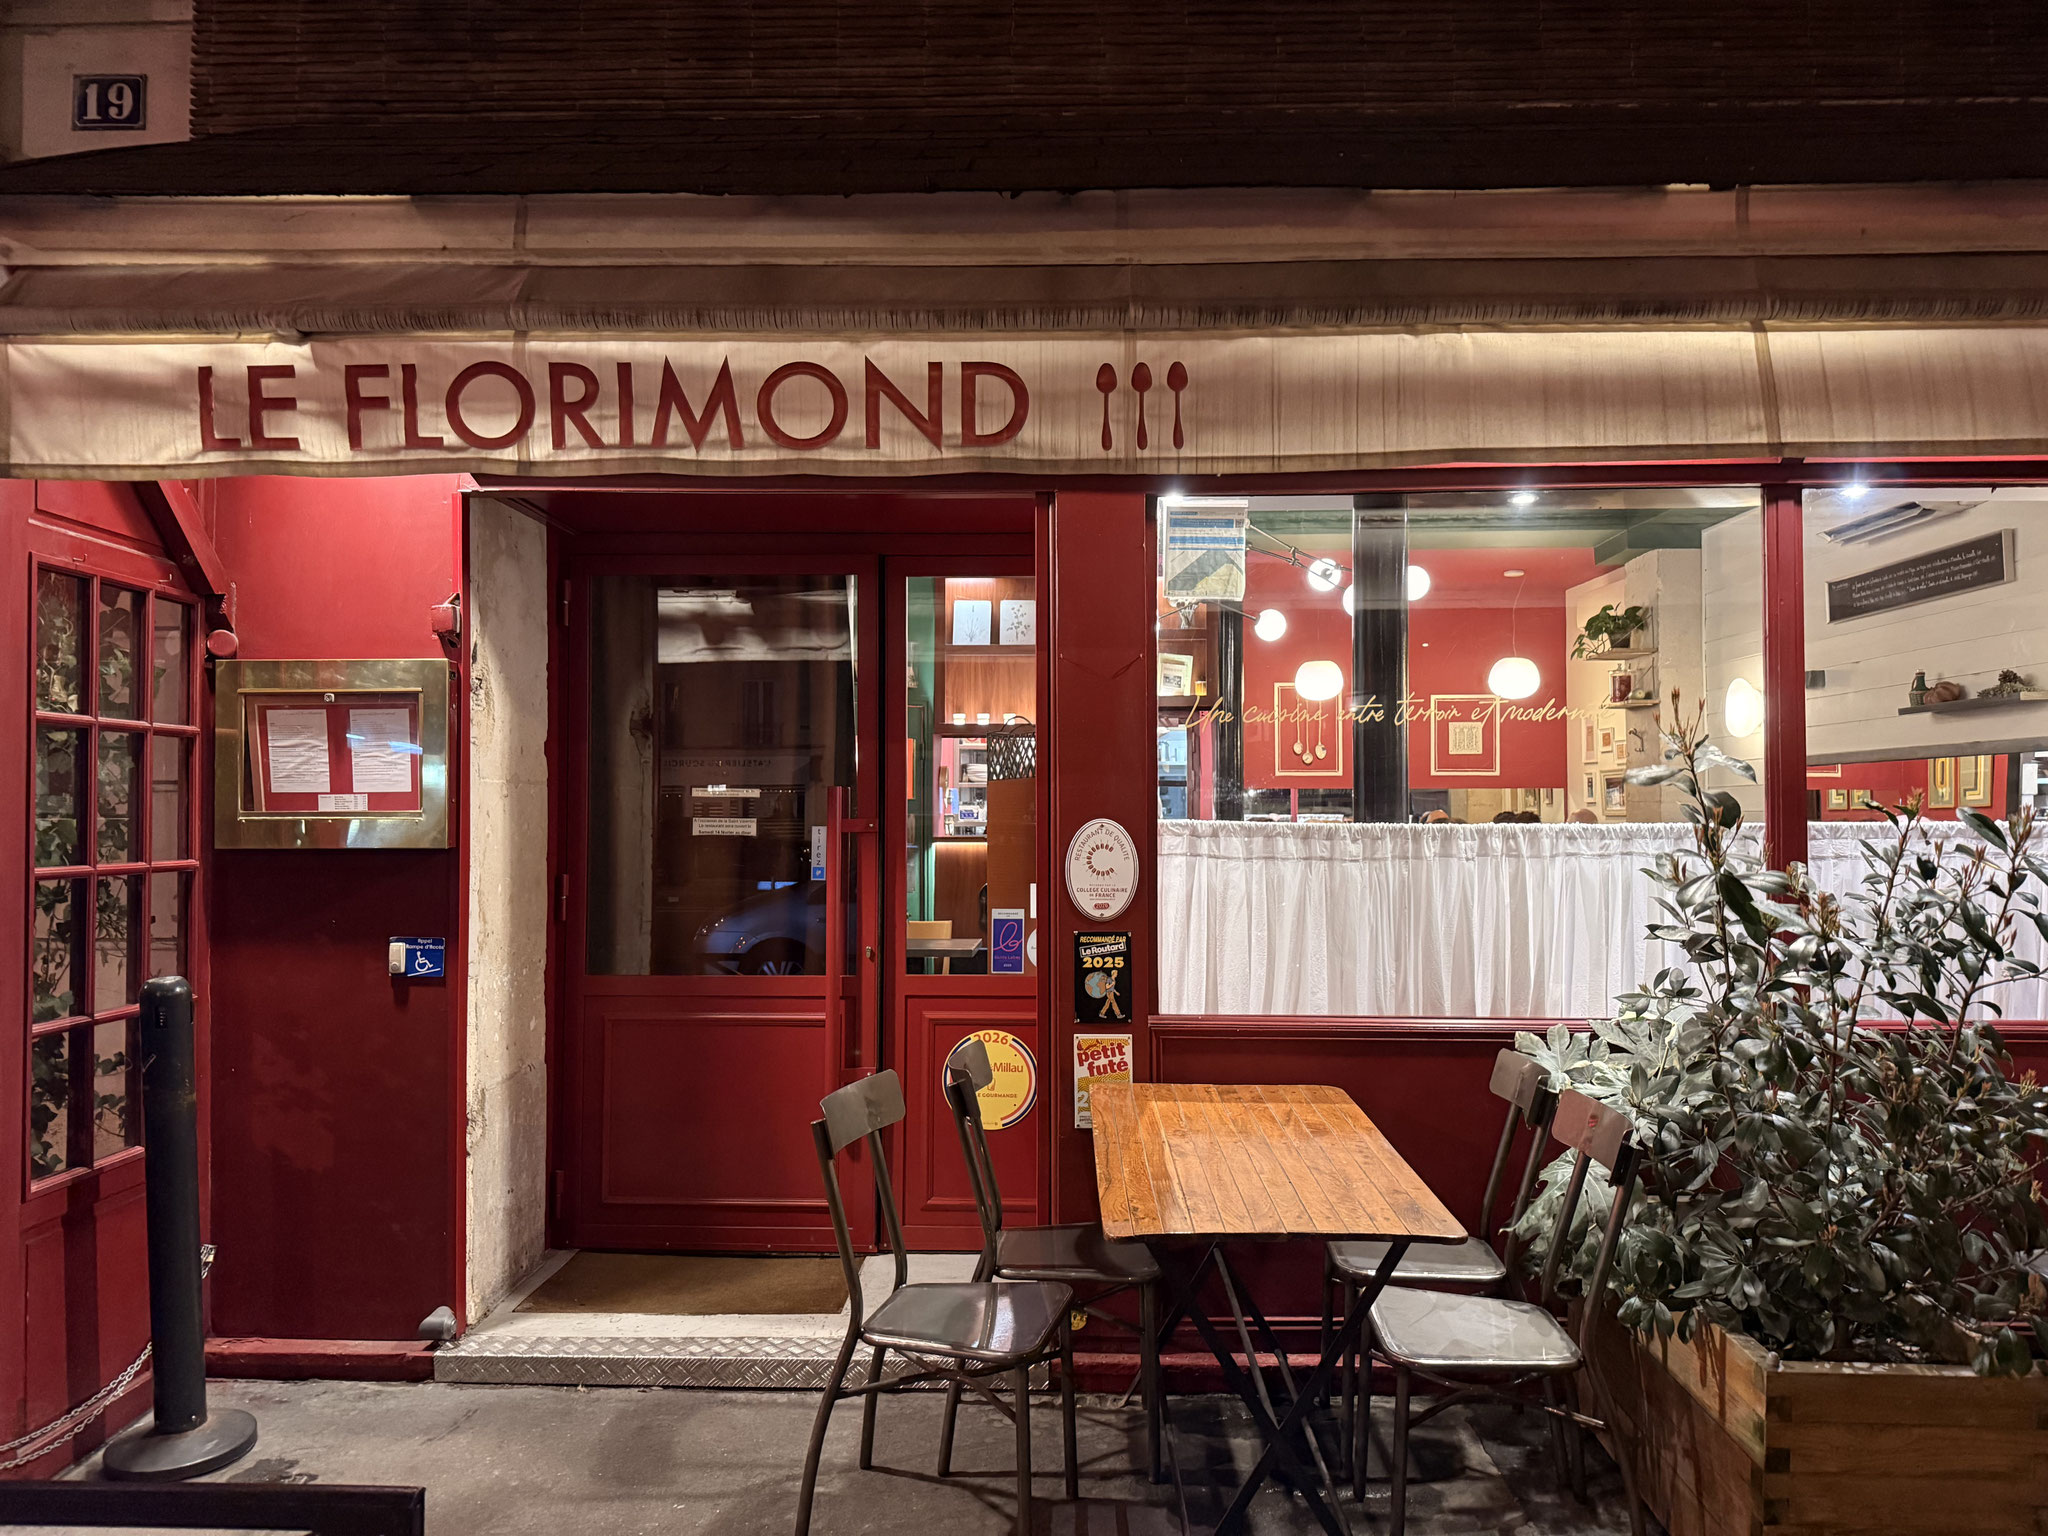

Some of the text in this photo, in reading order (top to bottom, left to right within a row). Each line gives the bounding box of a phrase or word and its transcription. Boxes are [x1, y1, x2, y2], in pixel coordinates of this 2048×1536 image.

[82, 83, 135, 121] 19
[198, 354, 1031, 452] LE FLORIMOND
[1185, 692, 1615, 733] Une cuisine entre terroir et moderné
[1074, 828, 1104, 861] RESTAURANT
[1104, 828, 1114, 838] DE
[1079, 935, 1127, 943] RECOMMANDÉ PAR
[1081, 942, 1125, 956] Le Routard
[1082, 956, 1125, 968] 2025
[1076, 1042, 1126, 1066] petit
[991, 1062, 1024, 1073] Millau
[1087, 1057, 1129, 1077] futé
